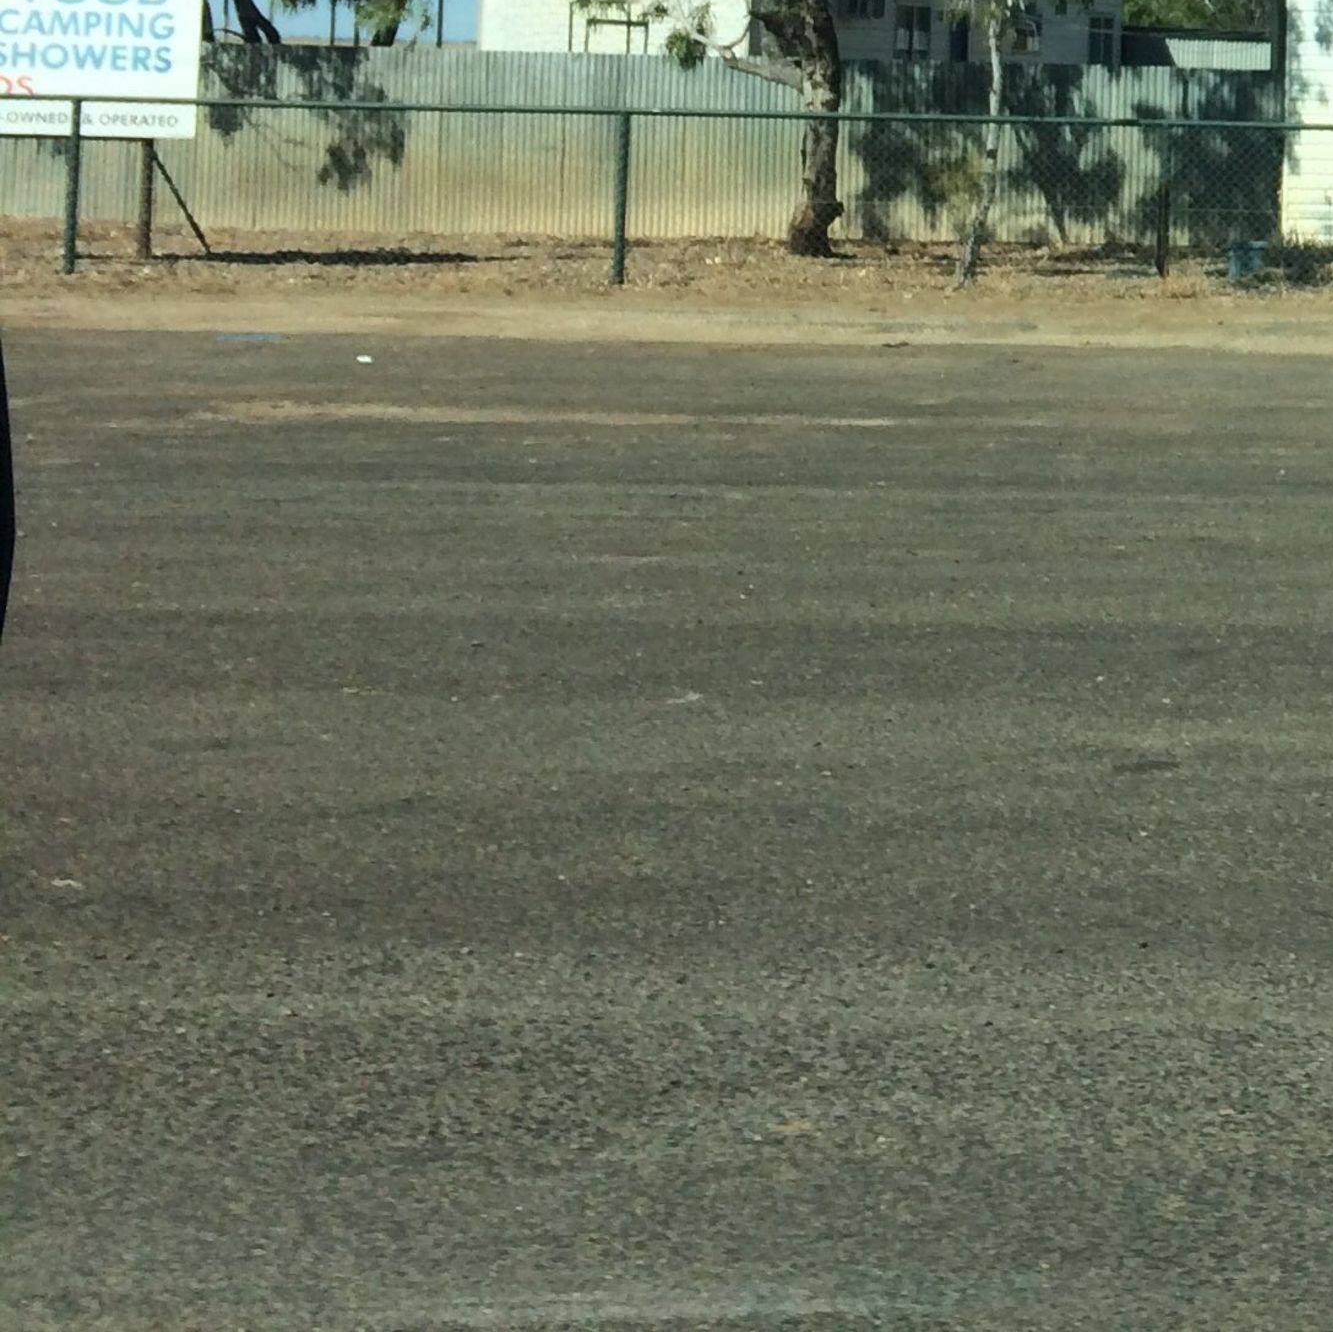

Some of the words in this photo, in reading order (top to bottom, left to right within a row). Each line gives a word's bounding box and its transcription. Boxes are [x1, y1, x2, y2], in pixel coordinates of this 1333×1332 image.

[0, 9, 175, 40] CAMPING
[7, 110, 68, 125] OWNED
[99, 113, 179, 128] OPERATED
